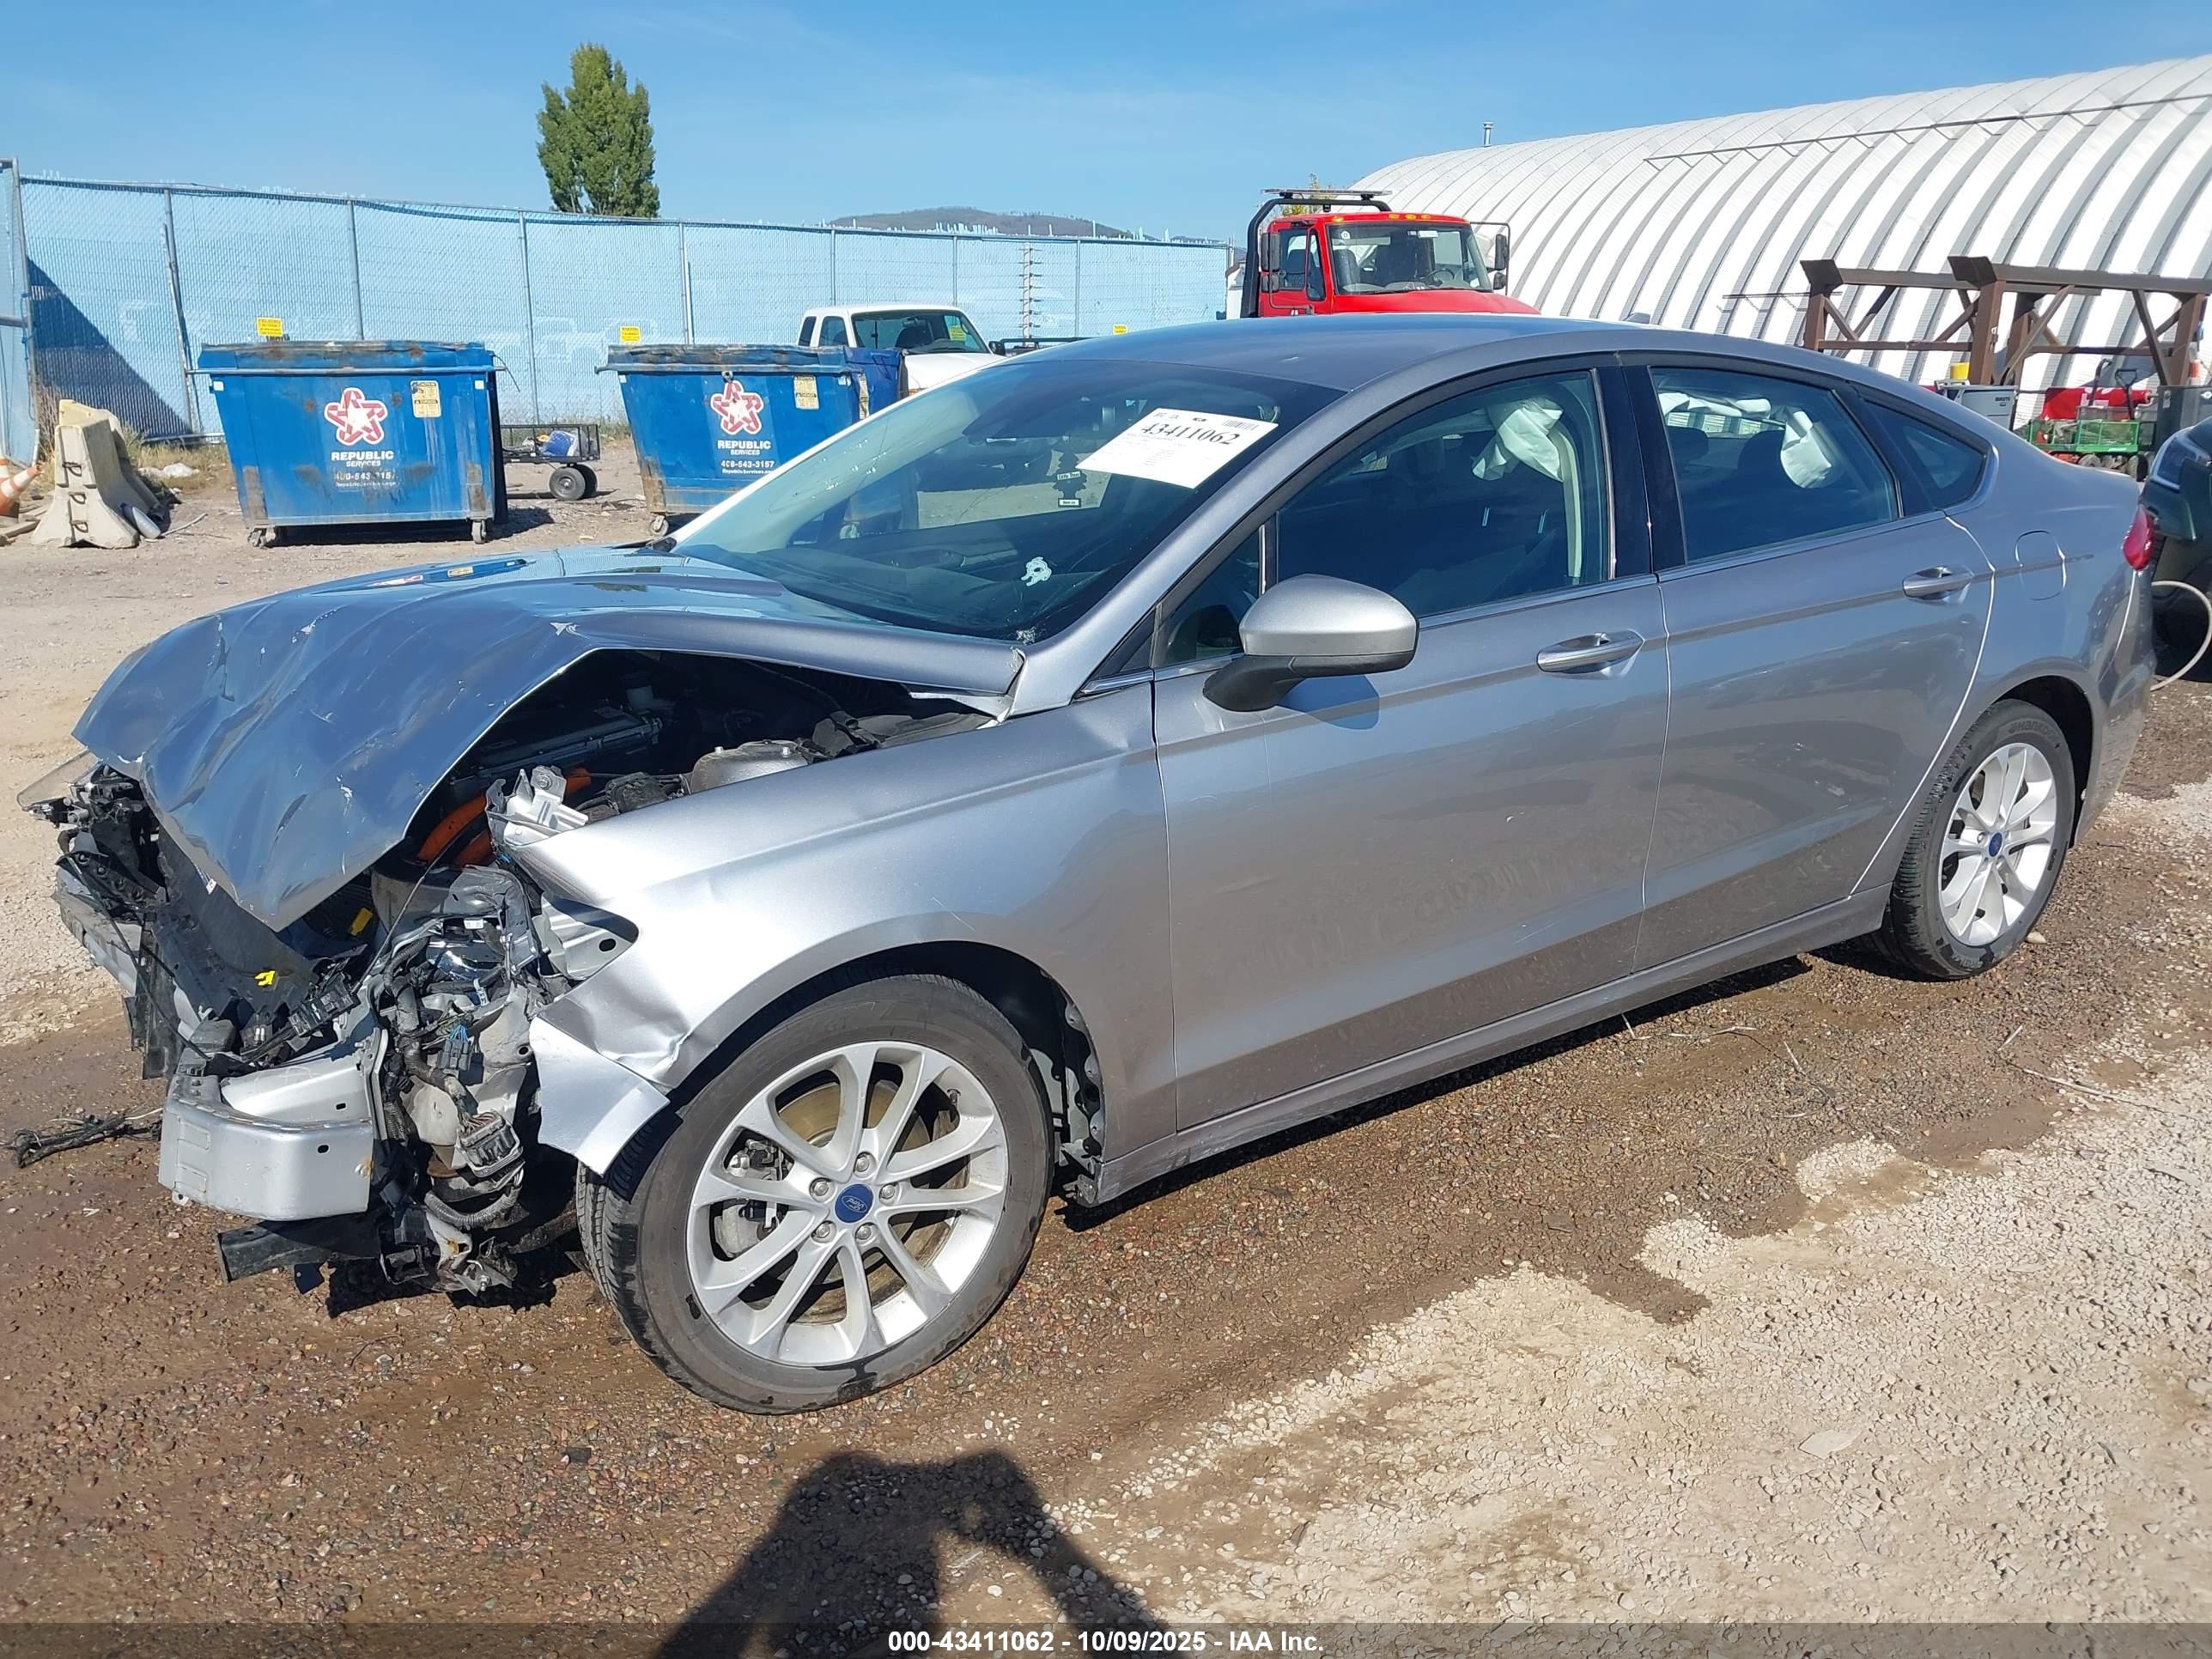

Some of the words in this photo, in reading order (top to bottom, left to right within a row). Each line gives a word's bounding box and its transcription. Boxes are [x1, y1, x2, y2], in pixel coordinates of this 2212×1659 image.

[1141, 422, 1241, 445] 43411062
[717, 440, 771, 449] REPUBLIC
[331, 451, 394, 461] REPUBLIC
